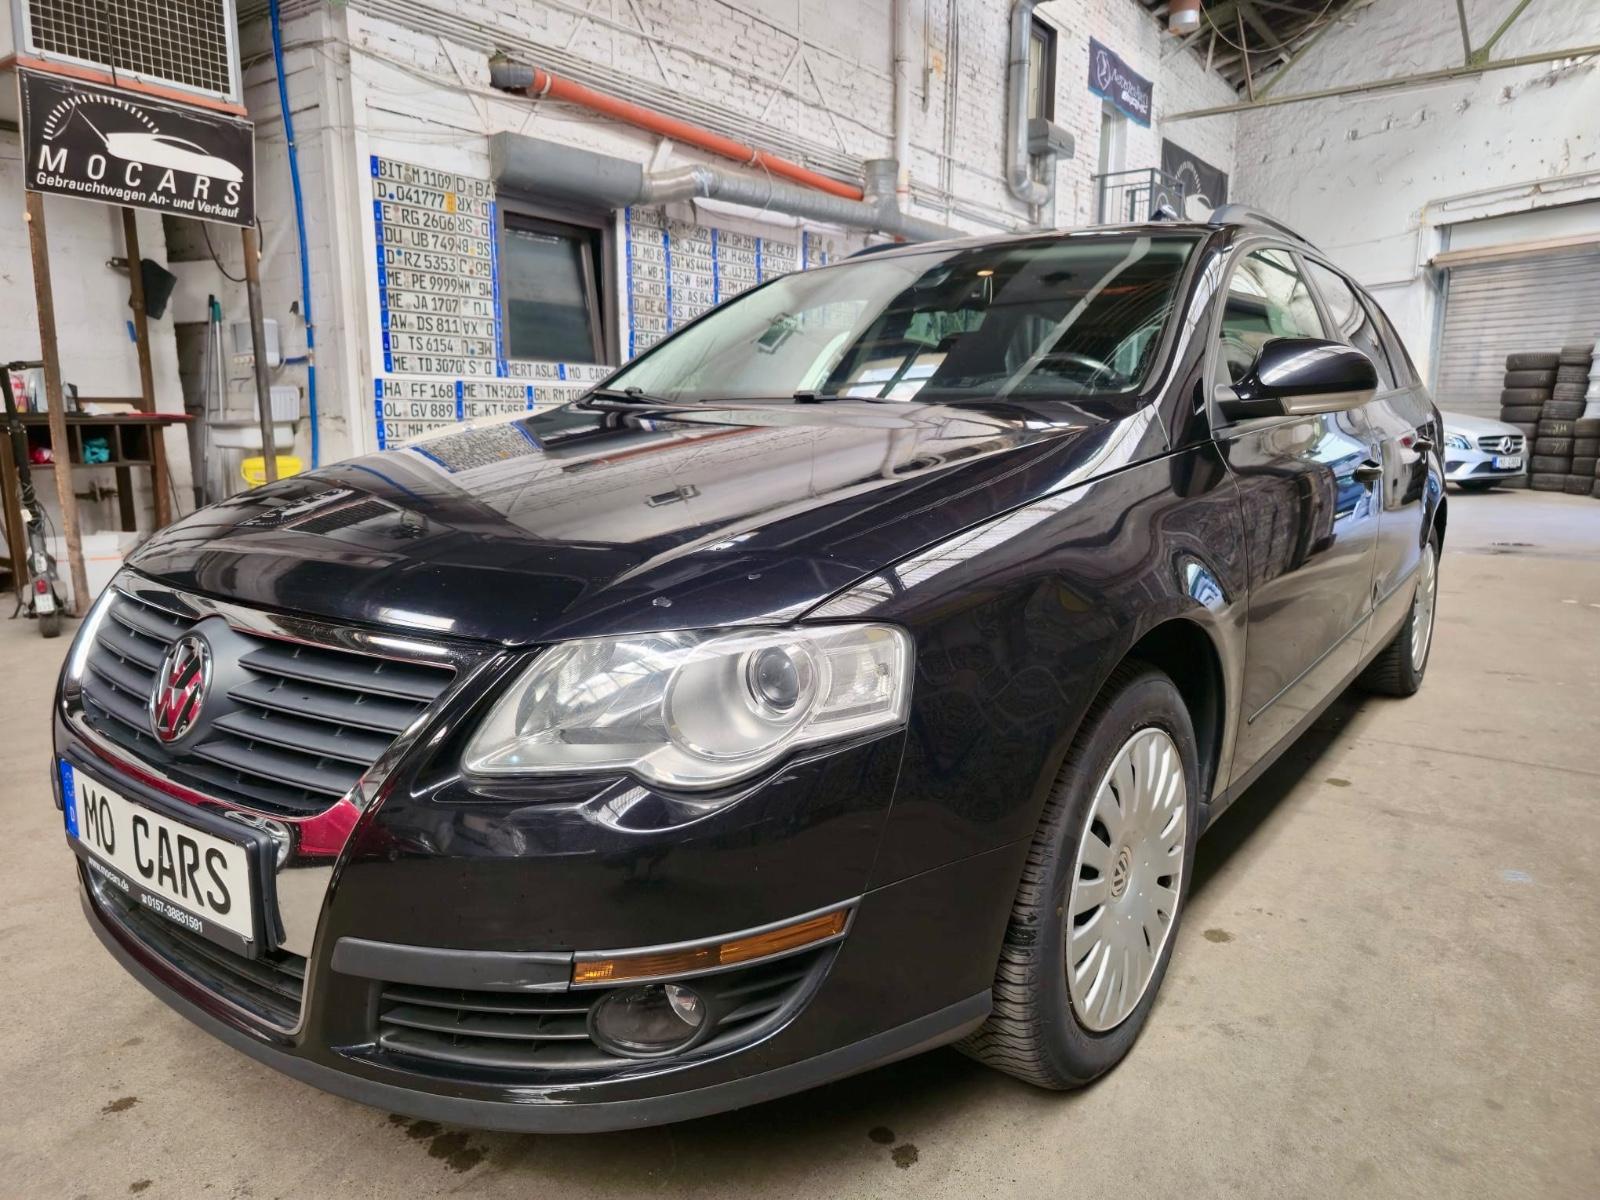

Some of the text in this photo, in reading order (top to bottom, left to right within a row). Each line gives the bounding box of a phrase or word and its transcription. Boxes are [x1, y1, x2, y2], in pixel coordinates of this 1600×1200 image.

[379, 160, 451, 189] BIT M 1109
[36, 172, 240, 218] Gebrauchtwagen An- und Verkauf
[377, 182, 387, 198] D
[383, 206, 454, 231] E RG 2606
[385, 228, 455, 251] DU UB 749
[386, 249, 456, 272] D RZ 5353
[387, 271, 457, 292] ME PE 9999
[388, 293, 458, 312] ME JA 1707
[390, 314, 459, 333] AW DS 811
[392, 335, 453, 353] D TS 6154
[393, 356, 408, 371] ME
[435, 359, 462, 373] 3070
[384, 382, 453, 398] HA FF 168
[463, 384, 476, 397] ME
[485, 385, 498, 397] TN
[384, 403, 453, 418] OL GV 889
[464, 403, 477, 417] ME
[485, 404, 497, 416] KT
[83, 784, 231, 915] MO CARS
